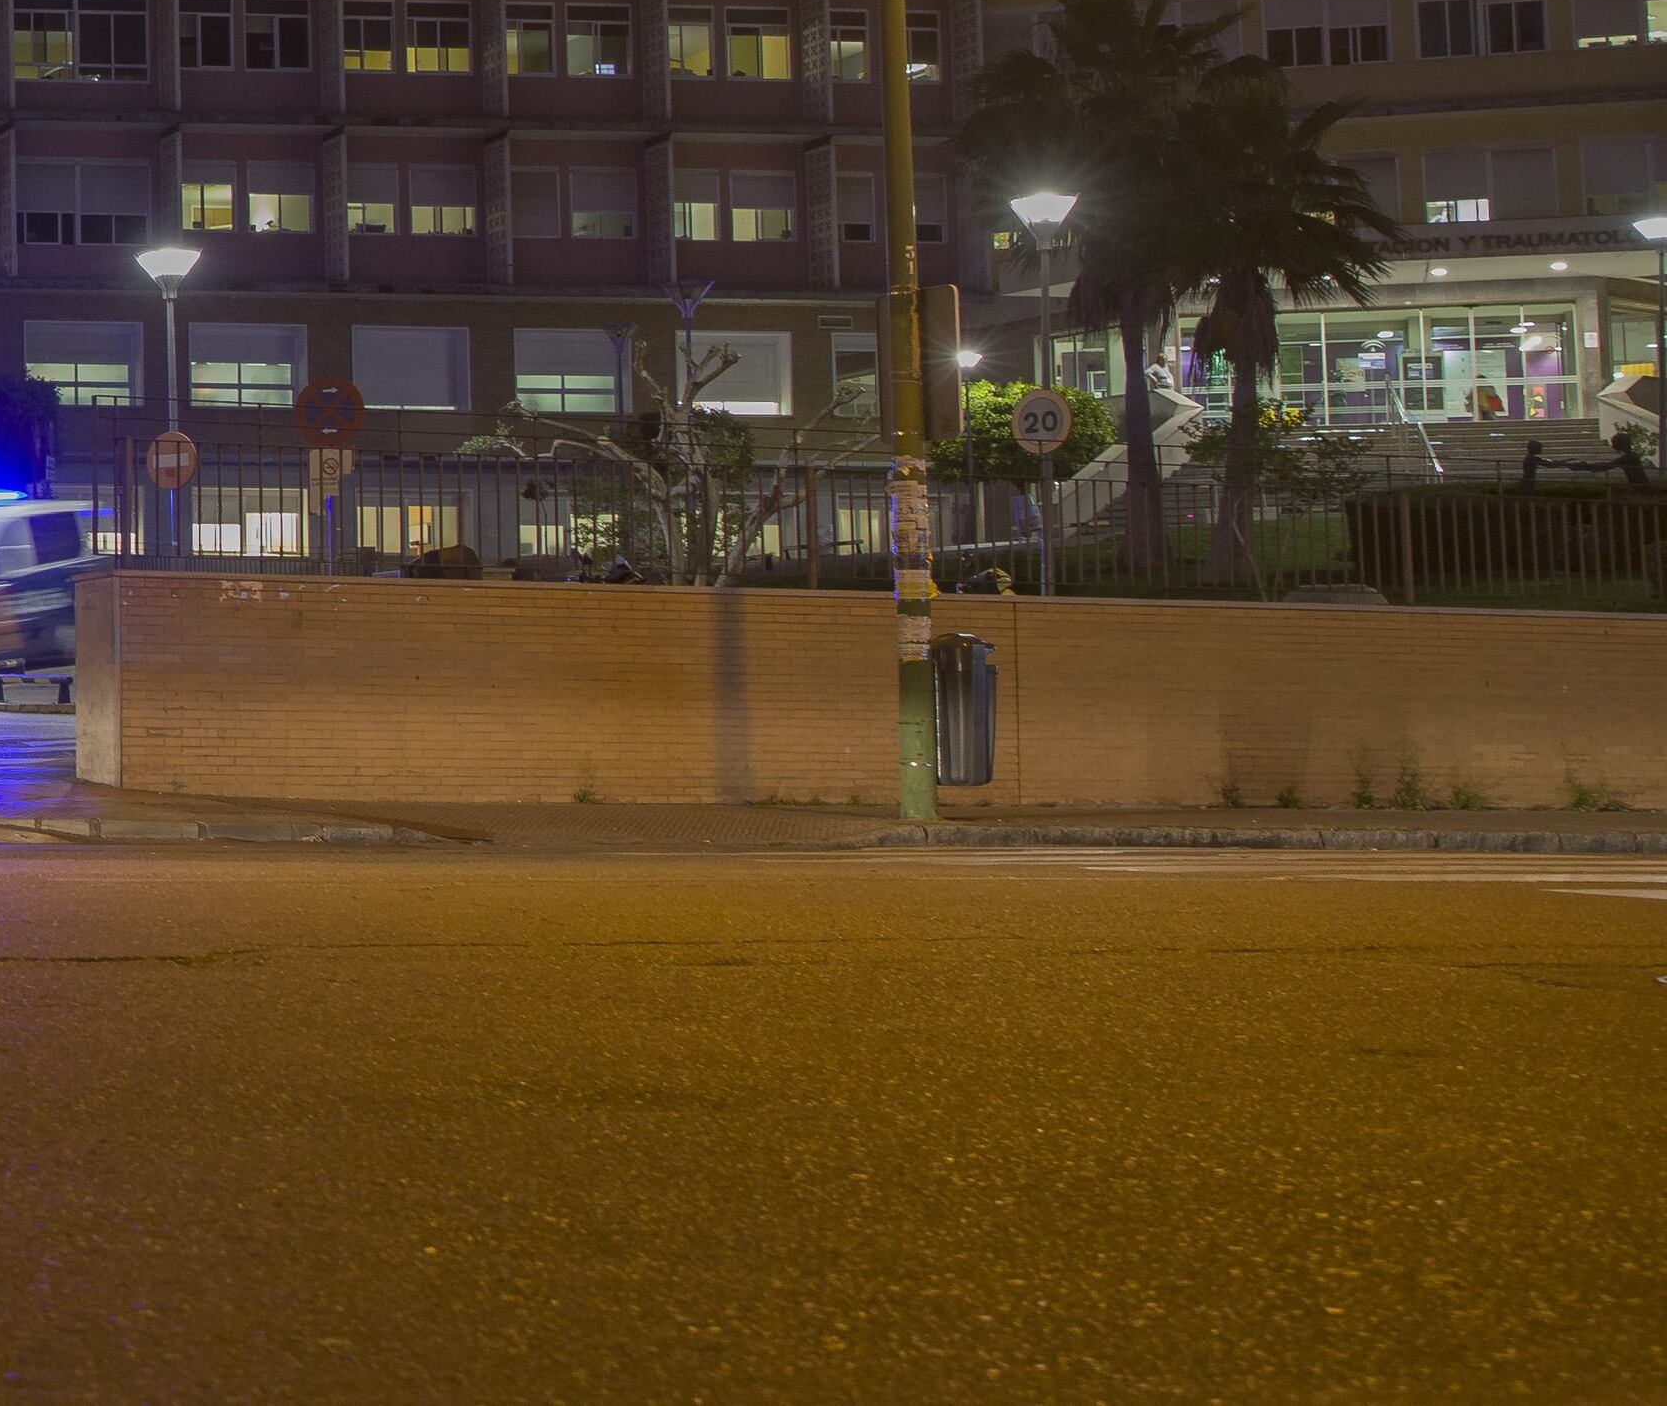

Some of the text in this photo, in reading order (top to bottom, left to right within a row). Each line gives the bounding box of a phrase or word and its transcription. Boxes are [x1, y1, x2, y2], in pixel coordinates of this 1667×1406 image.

[1458, 235, 1476, 251] Y
[1482, 230, 1630, 249] TRAUMATOL
[1024, 410, 1058, 434] 20
